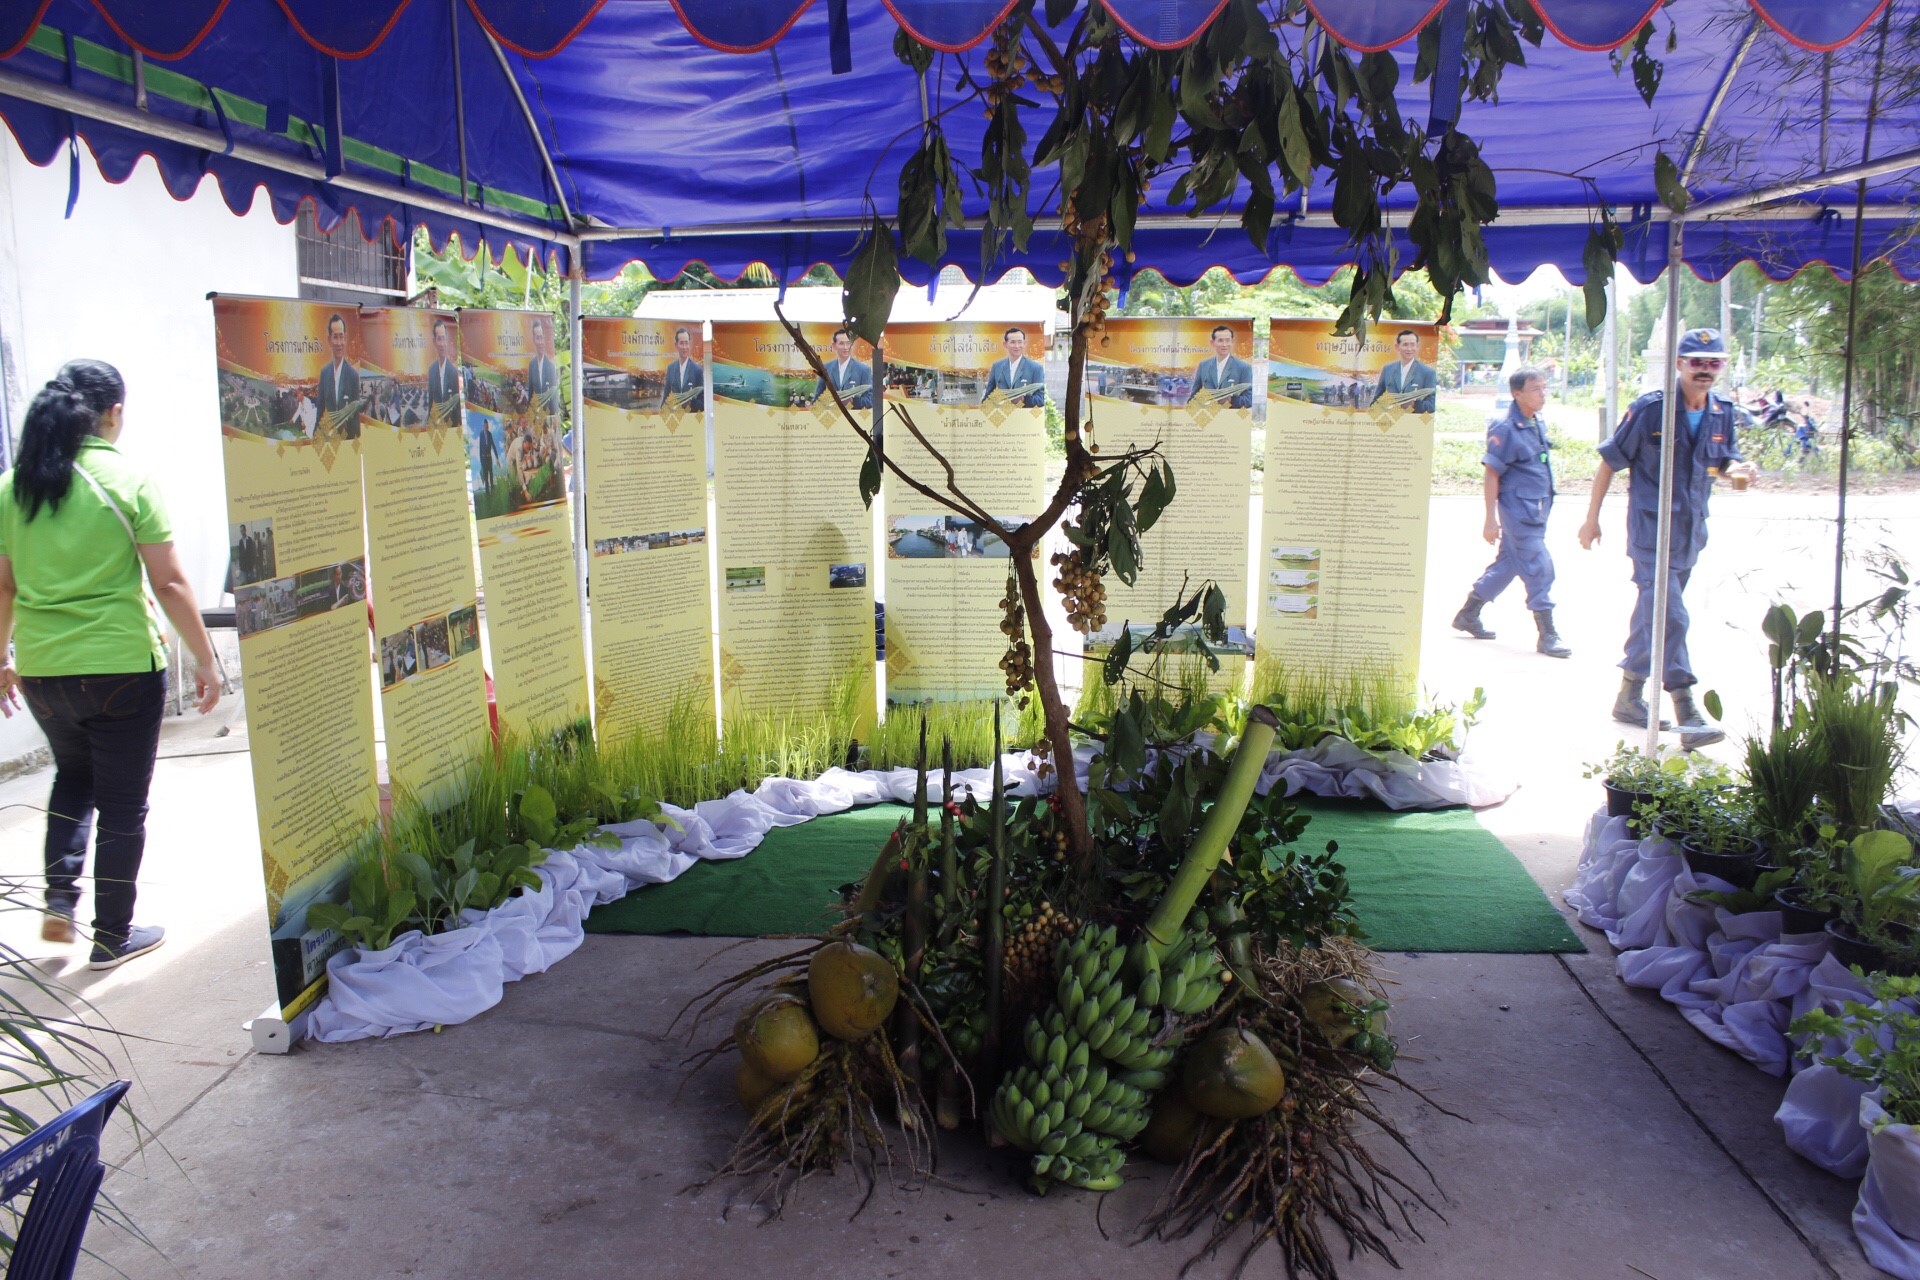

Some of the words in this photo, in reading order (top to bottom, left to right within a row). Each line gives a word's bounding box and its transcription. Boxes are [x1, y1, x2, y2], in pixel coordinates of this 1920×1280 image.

[263, 331, 323, 354] โครงการแก้มลิง
[621, 329, 665, 345] บึงมักกะสัน
[929, 335, 998, 354] น้ำดีไล่น้ำเสีย
